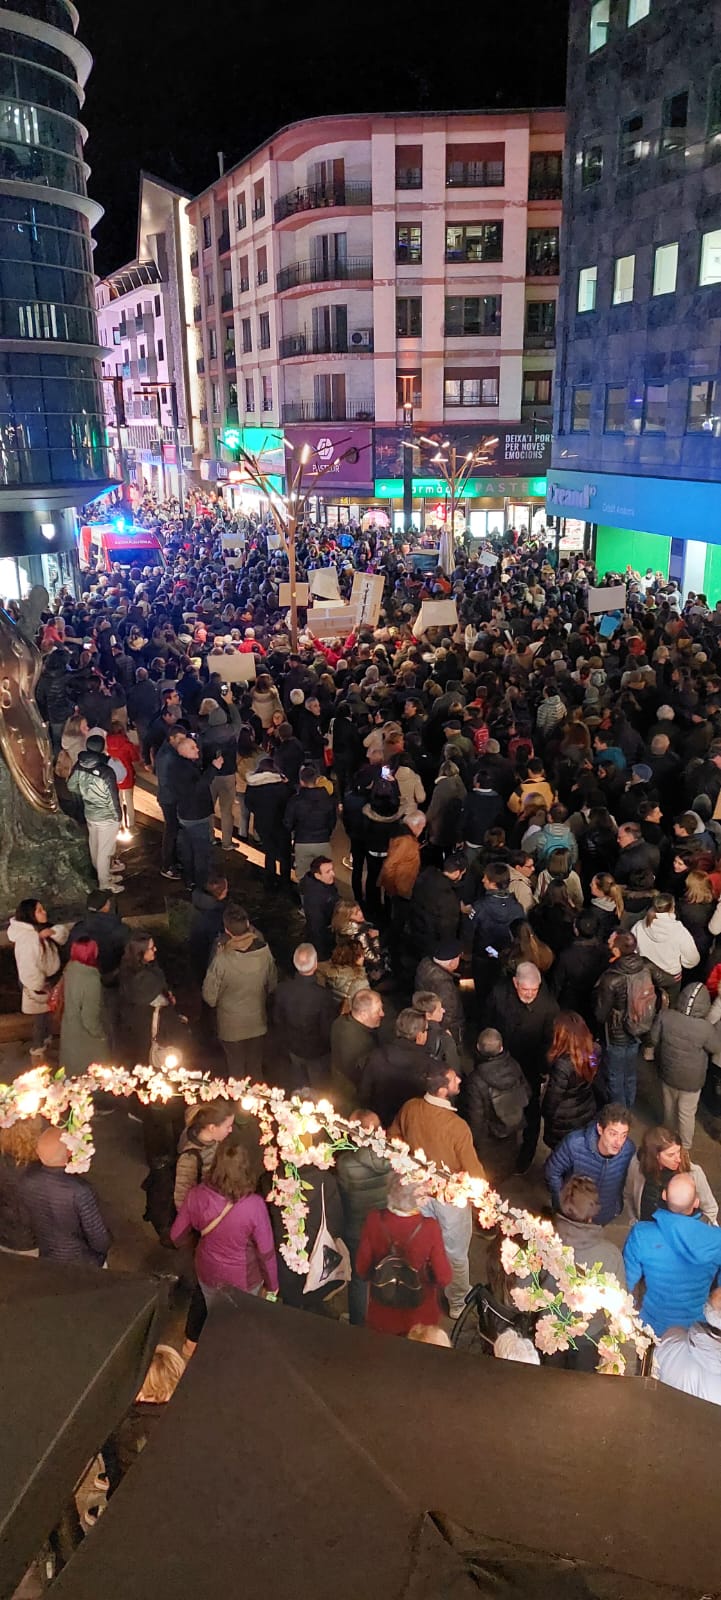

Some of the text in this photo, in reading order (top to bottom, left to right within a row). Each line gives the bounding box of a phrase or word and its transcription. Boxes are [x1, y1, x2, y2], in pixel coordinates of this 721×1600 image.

[505, 442, 546, 451] PER NOVES
[504, 450, 543, 460] EMOCIONS
